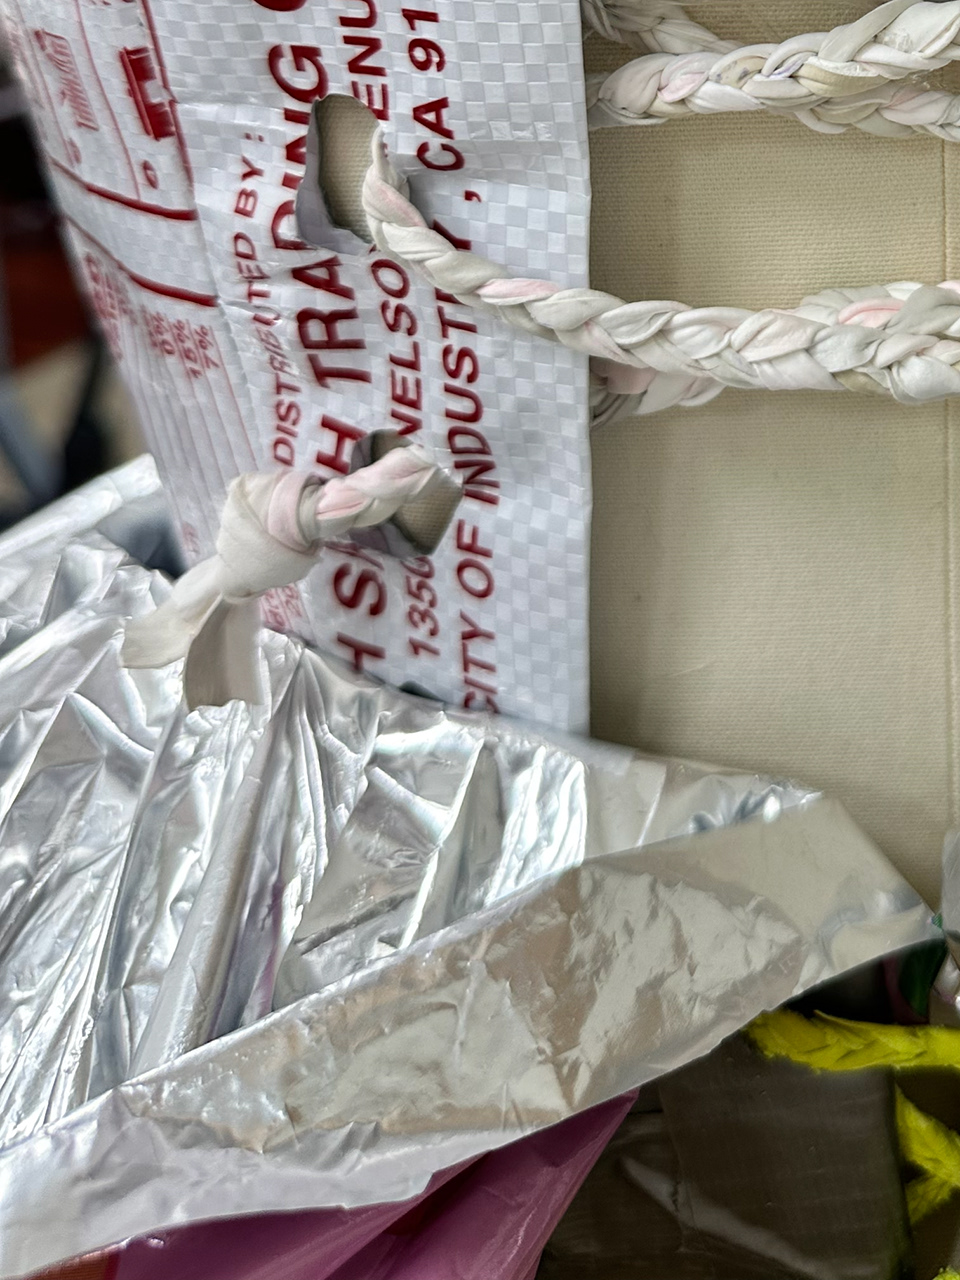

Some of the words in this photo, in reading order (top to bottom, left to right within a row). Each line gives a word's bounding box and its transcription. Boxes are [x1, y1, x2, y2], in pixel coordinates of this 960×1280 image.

[412, 95, 466, 171] CA
[233, 231, 301, 465] DISTRIBUTED
[369, 241, 425, 446] NELSO
[432, 218, 500, 504] INDUSTY
[456, 518, 494, 598] OF
[457, 610, 498, 713] CITY
